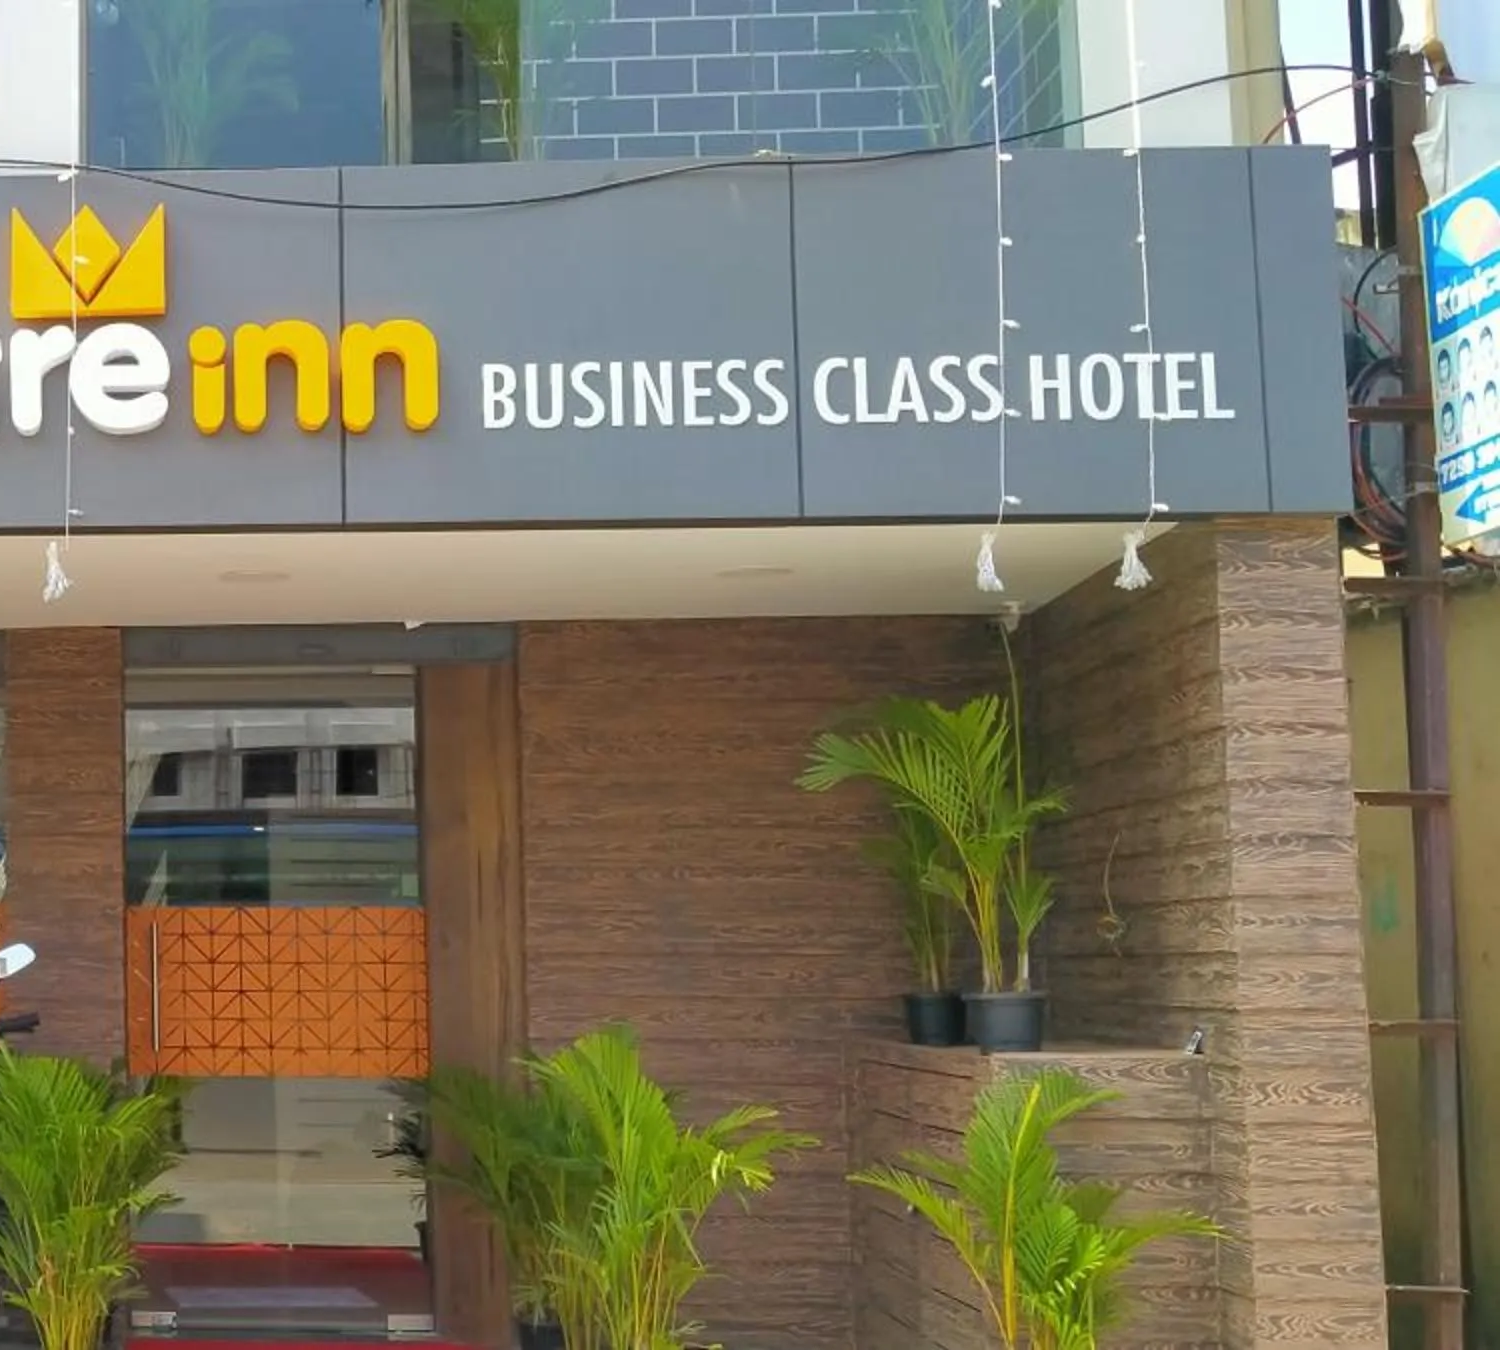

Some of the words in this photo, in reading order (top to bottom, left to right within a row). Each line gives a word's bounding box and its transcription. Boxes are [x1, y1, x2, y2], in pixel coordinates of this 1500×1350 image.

[188, 319, 440, 435] inn
[481, 358, 790, 430] BUSINESS
[813, 354, 1004, 425] CLASS
[1029, 352, 1236, 422] HOTEL
